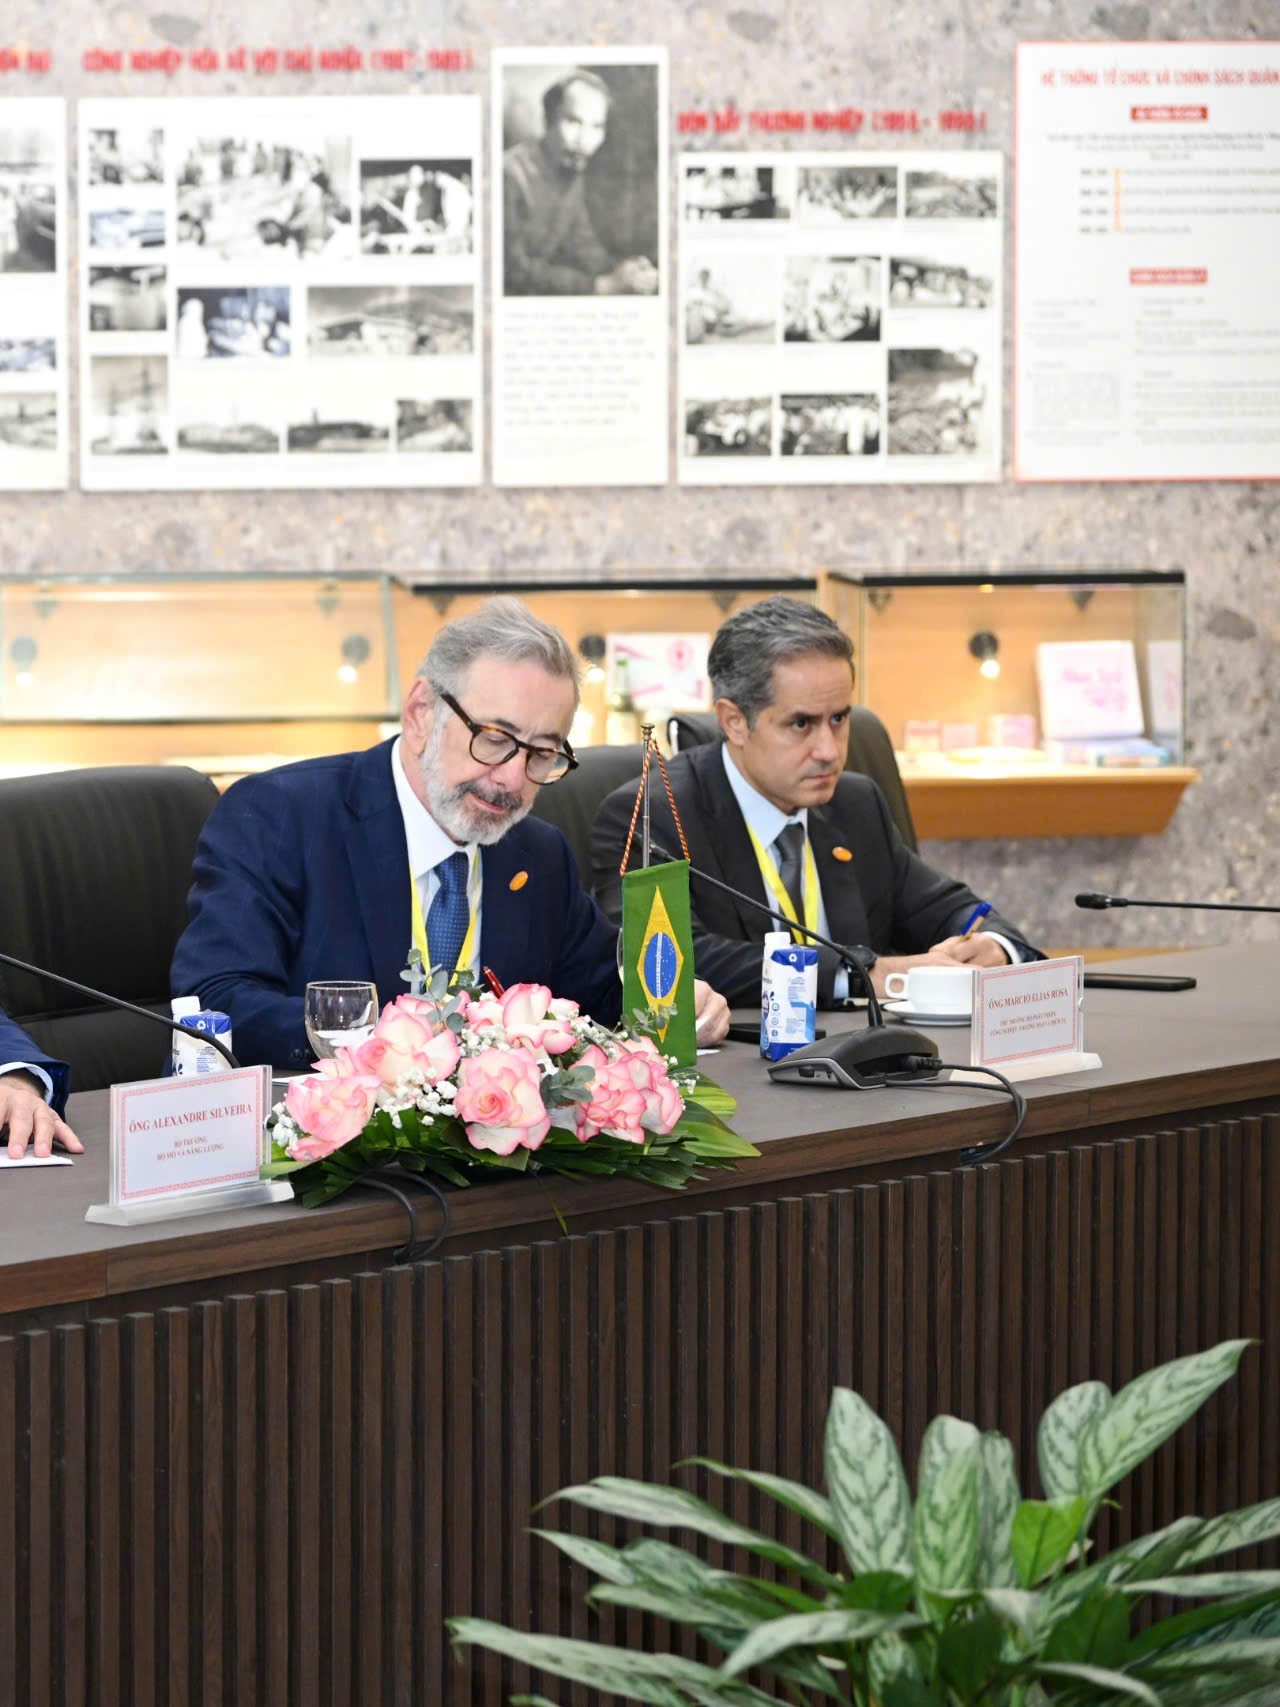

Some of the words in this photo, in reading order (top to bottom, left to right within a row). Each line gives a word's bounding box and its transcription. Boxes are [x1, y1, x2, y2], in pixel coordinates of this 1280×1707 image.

[129, 1118, 150, 1134] ÔNG
[151, 1110, 208, 1129] ALEXANDRE
[209, 1103, 252, 1120] SILVEIRA
